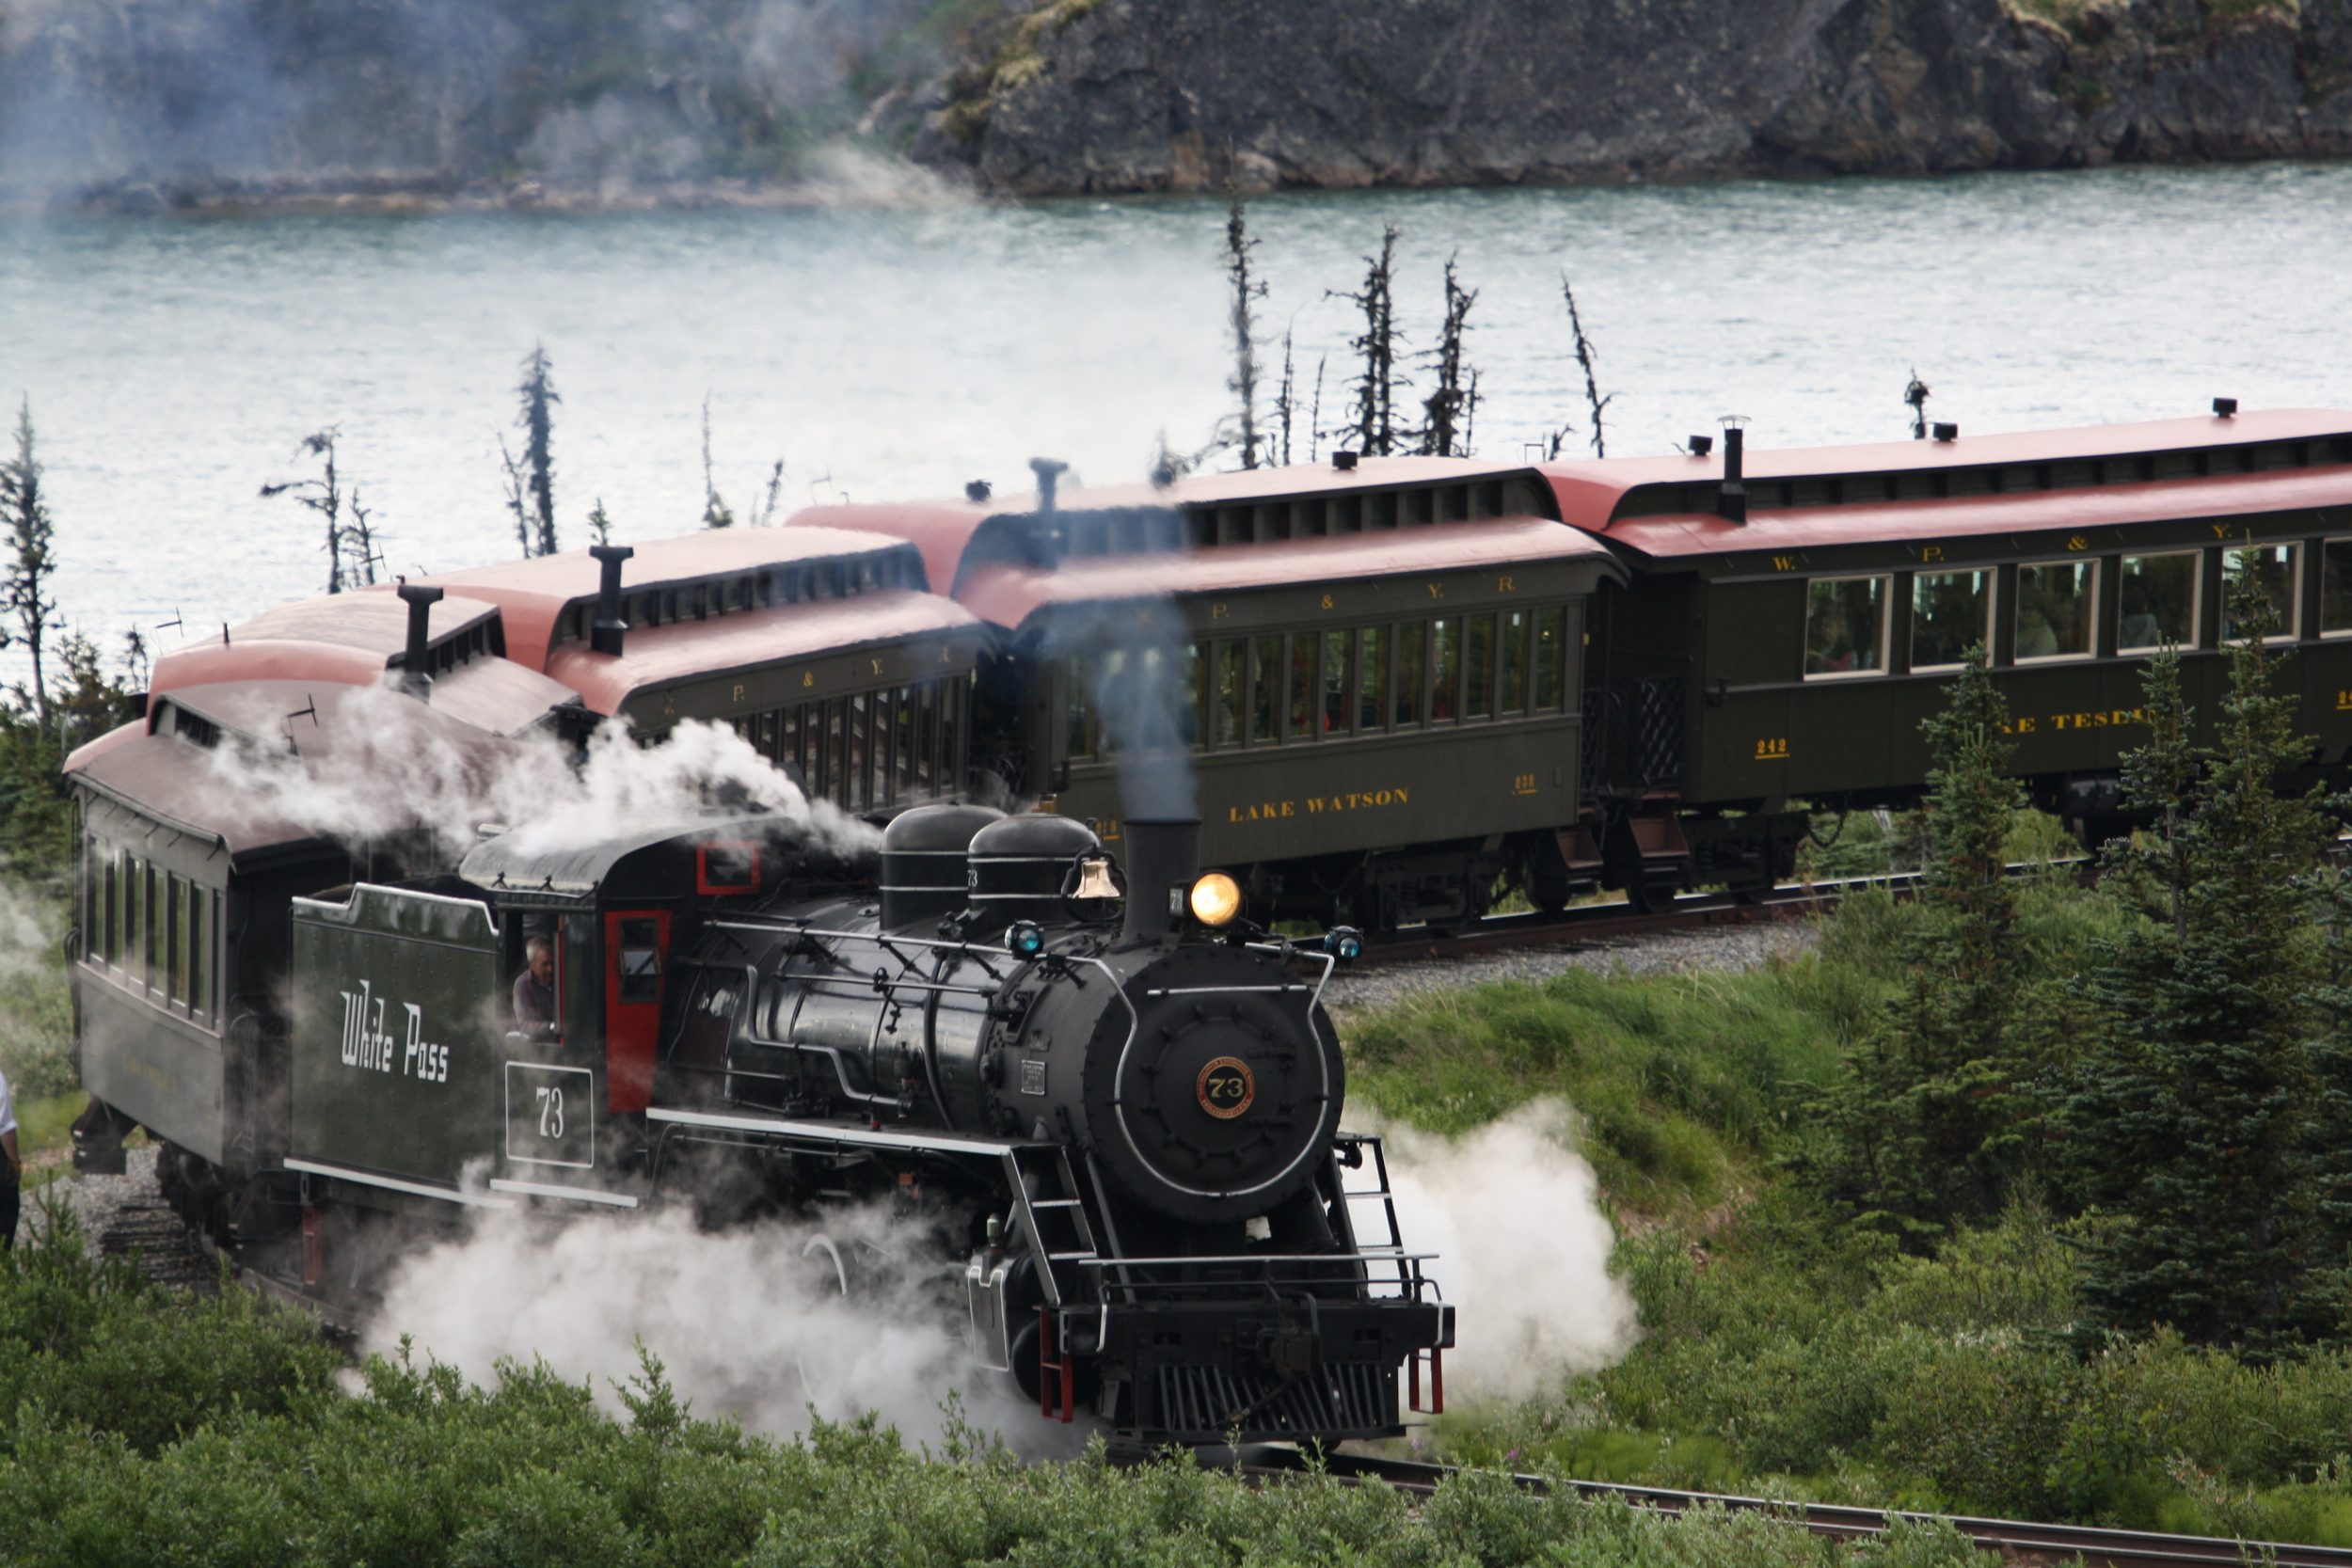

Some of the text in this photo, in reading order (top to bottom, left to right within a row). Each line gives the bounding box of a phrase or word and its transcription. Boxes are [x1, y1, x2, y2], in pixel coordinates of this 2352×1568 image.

[1772, 523, 2233, 571] W. P. & Y.
[1212, 577, 1516, 620] P. & Y. R.
[733, 685, 745, 702] P.
[803, 671, 814, 688] &
[871, 659, 883, 675] Y.
[1756, 739, 1787, 753] 242
[1229, 788, 1409, 822] LAKE WATSON
[967, 869, 978, 887] 73
[340, 979, 449, 1083] White Pass
[1208, 1078, 1244, 1098] 73
[535, 1086, 564, 1139] 73
